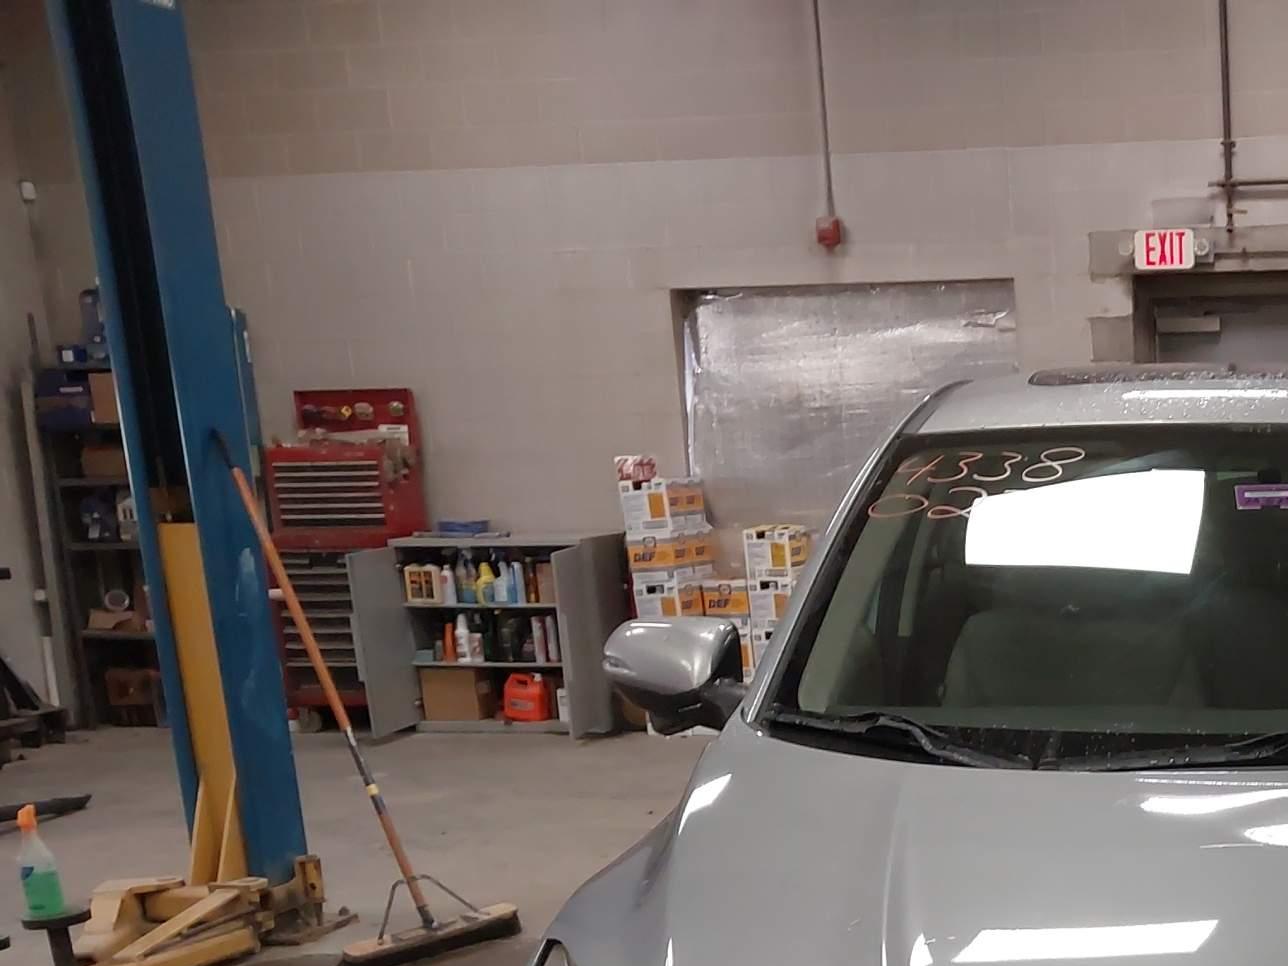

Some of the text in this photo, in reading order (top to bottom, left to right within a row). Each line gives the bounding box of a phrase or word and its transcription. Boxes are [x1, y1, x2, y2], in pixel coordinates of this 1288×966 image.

[1145, 232, 1185, 266] EXIT
[897, 447, 1085, 486] 4338
[868, 486, 1025, 519] 02
[708, 599, 730, 609] DEF
